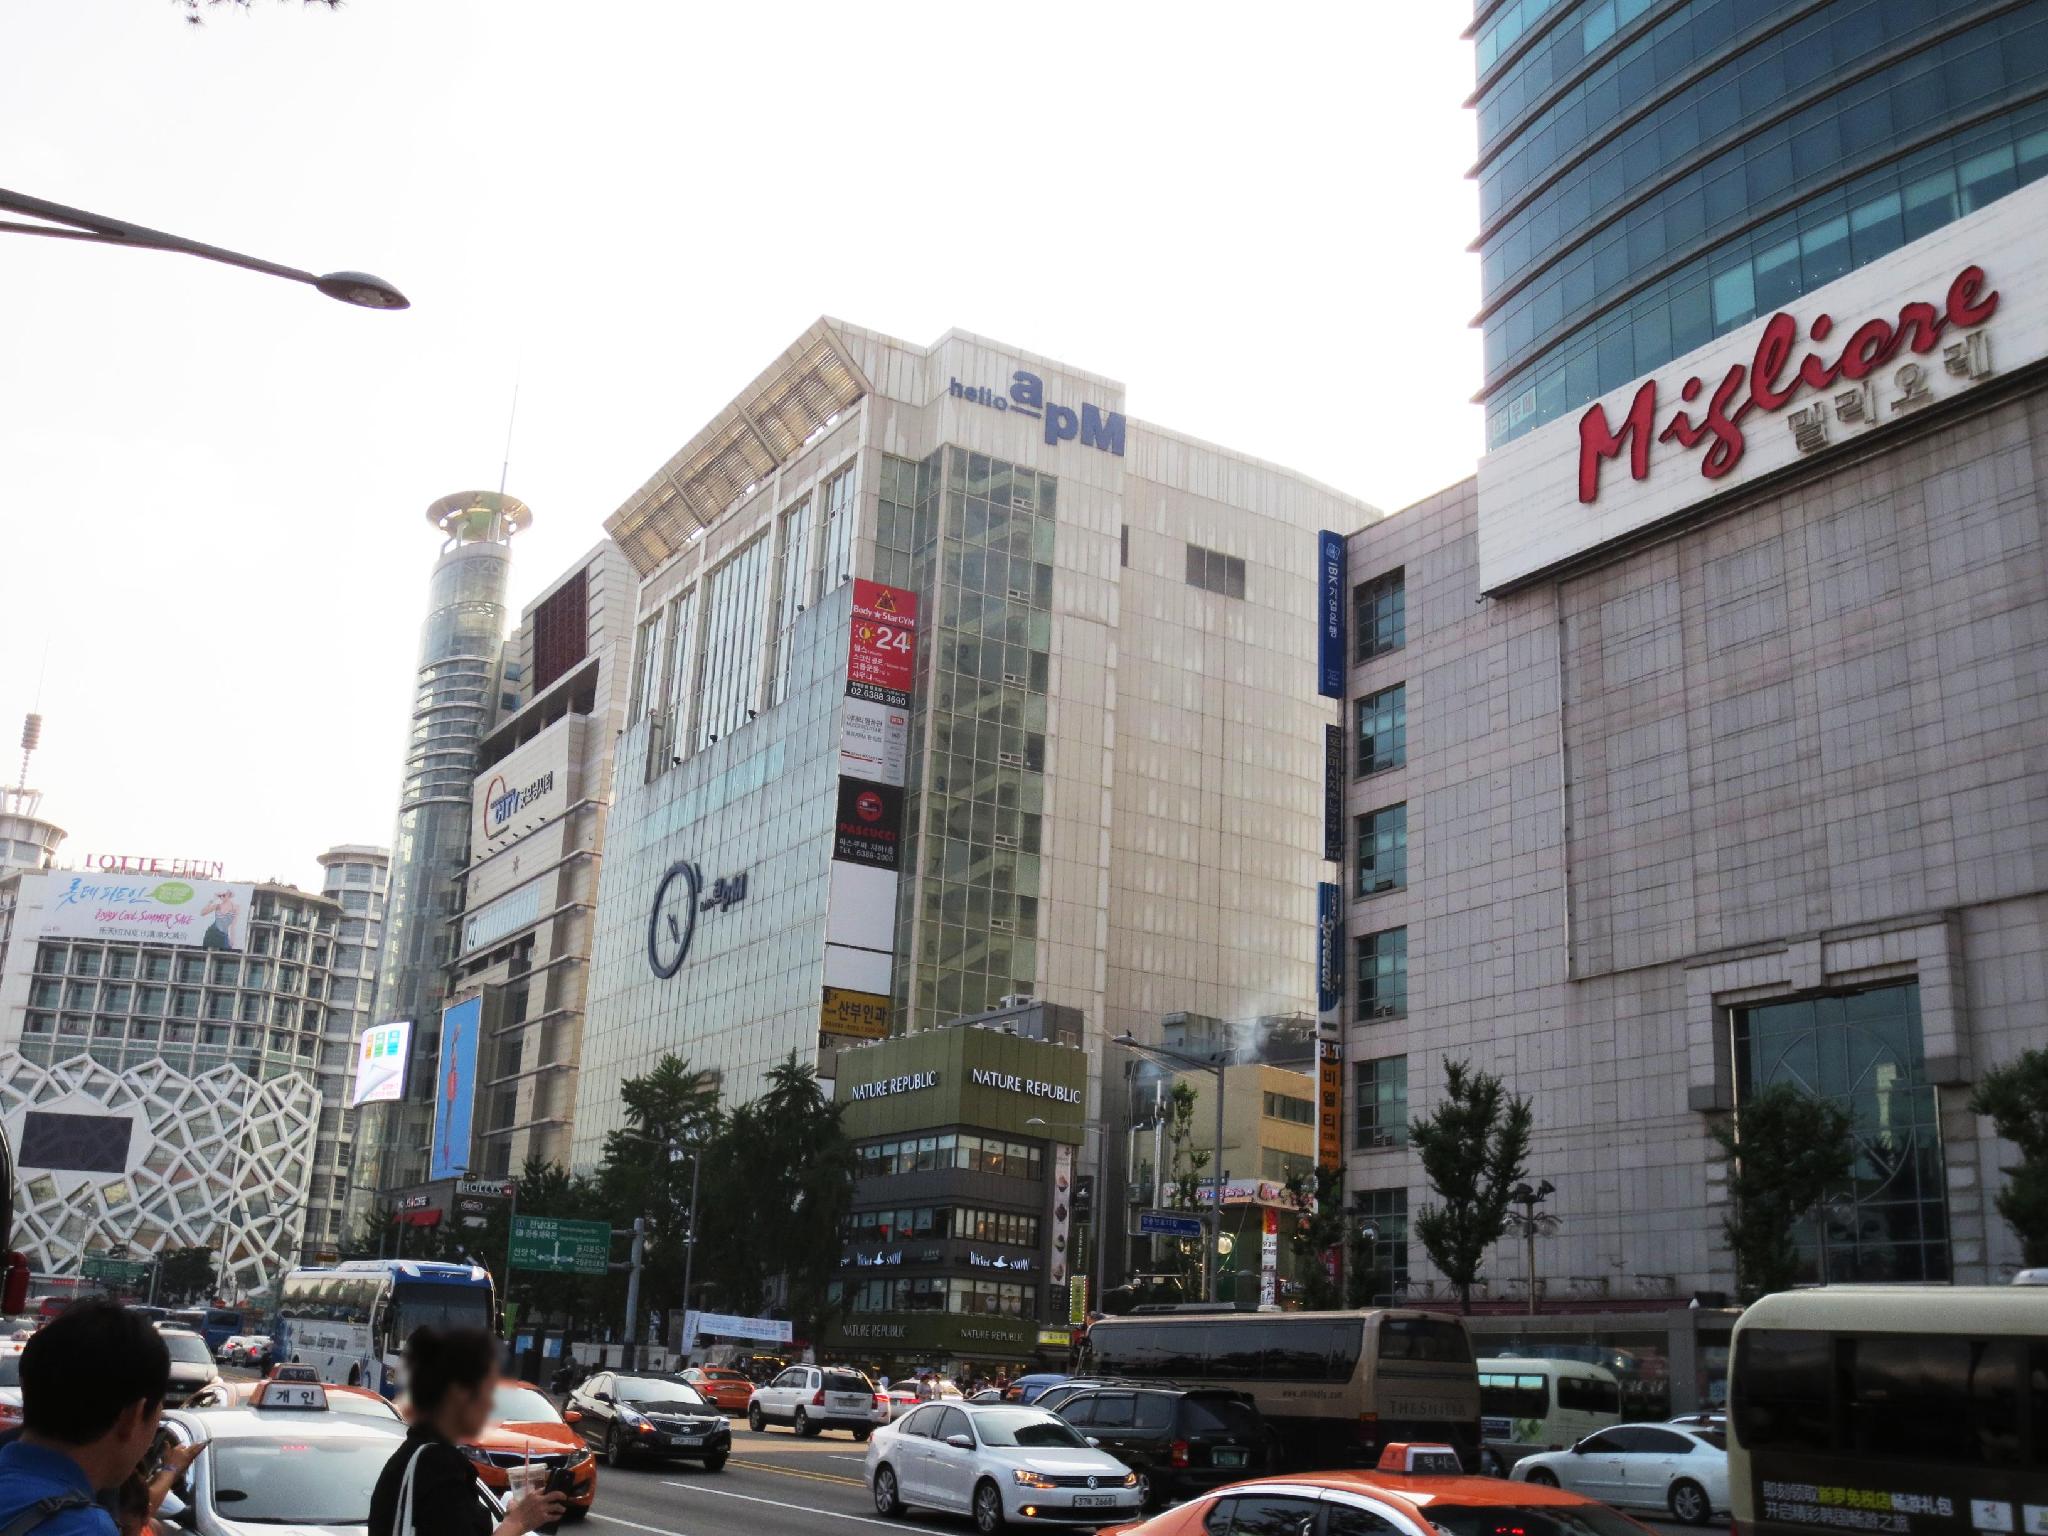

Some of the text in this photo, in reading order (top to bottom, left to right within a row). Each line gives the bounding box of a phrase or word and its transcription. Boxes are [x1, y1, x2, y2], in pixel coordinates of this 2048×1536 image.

[1578, 265, 2000, 504] Migliore
[1788, 329, 1993, 453] 밀리오레
[950, 370, 1126, 457] hello apM
[853, 604, 872, 617] Body
[876, 626, 911, 654] 24
[852, 670, 873, 681] 사우나
[839, 823, 897, 841] PASCUCCI
[86, 854, 224, 877] LOTTE FITIN
[55, 878, 96, 911] 롯데
[839, 1000, 888, 1026] 산부인과
[852, 1070, 937, 1101] NATURE REPUBLIC
[972, 1068, 1081, 1104] NATURE REPUBLIC
[842, 1324, 905, 1338] NATURE REPUBLIC
[960, 1328, 1024, 1342] NATURE REPUBLIC
